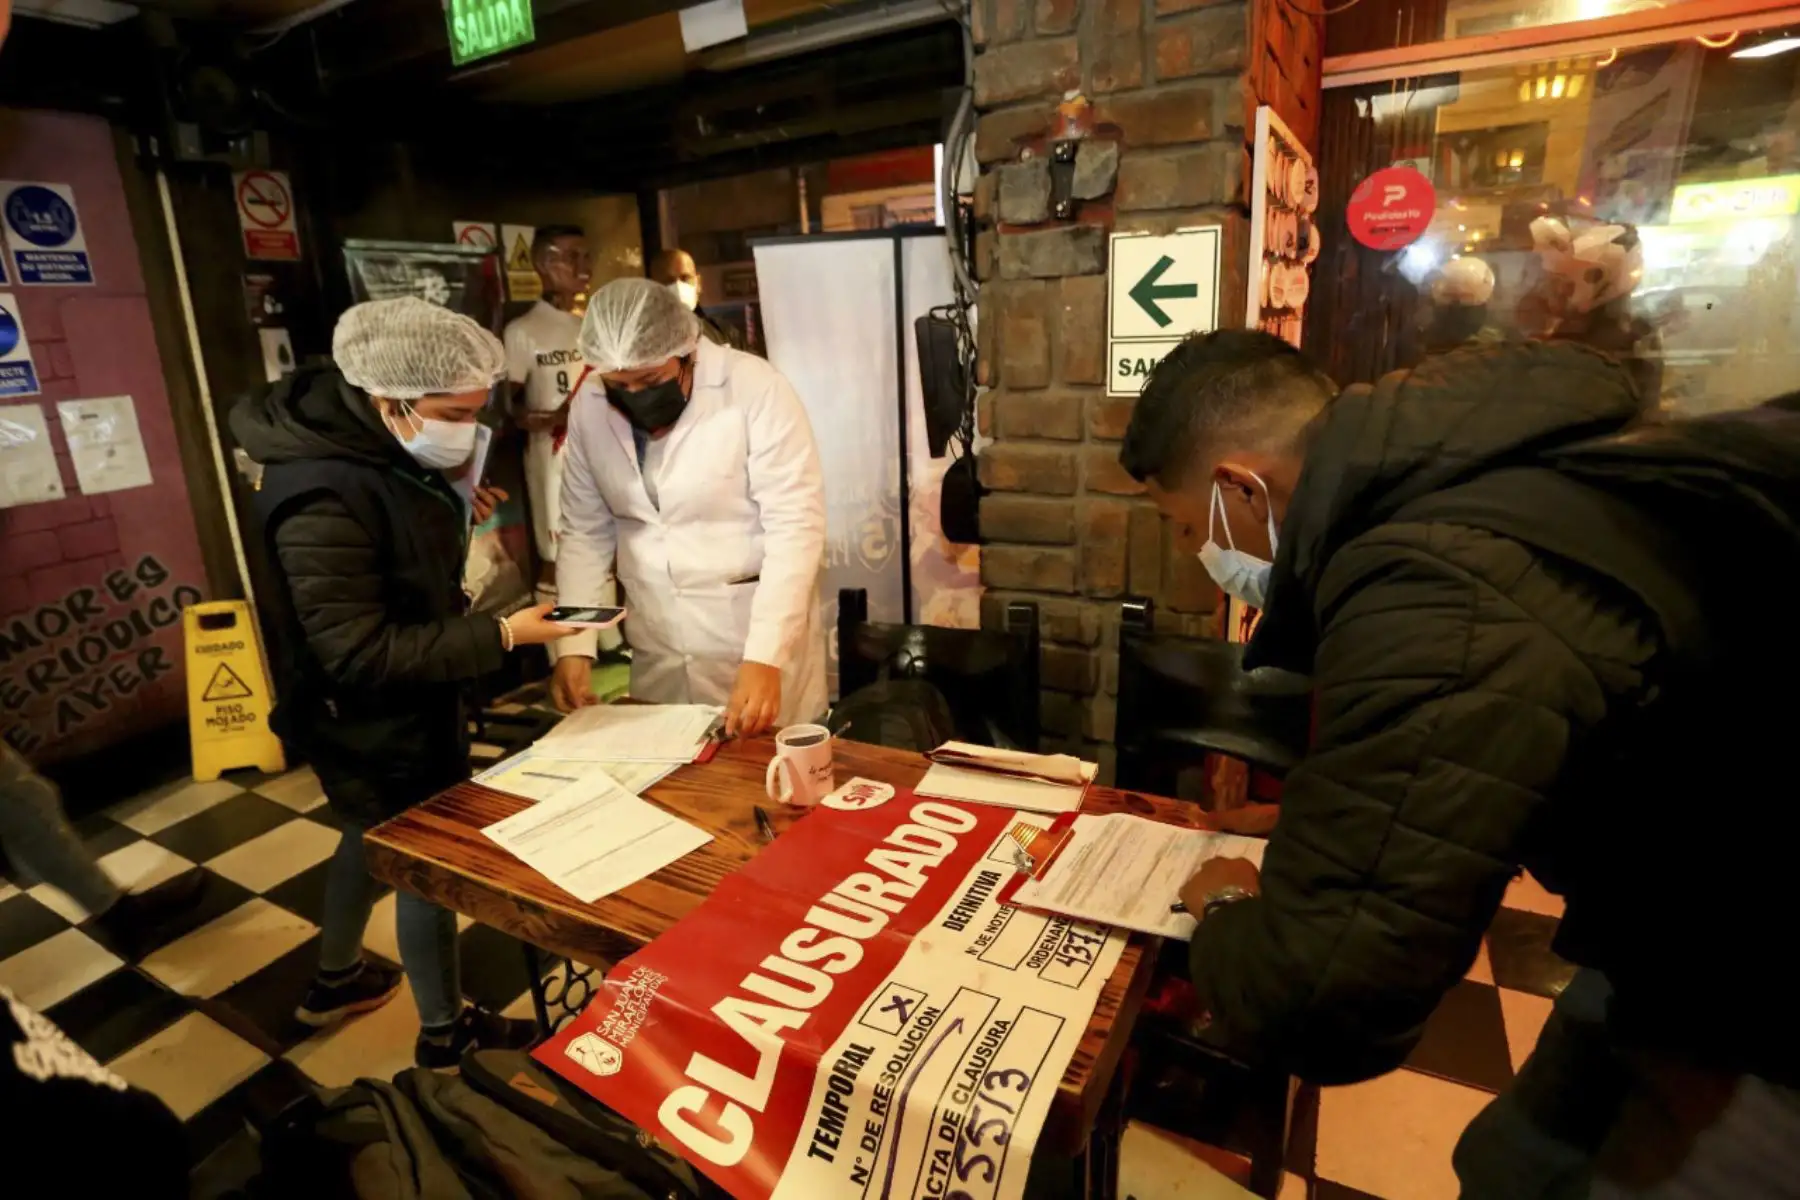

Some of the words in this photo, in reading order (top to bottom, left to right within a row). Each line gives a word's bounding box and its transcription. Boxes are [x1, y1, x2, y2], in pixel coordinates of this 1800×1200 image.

[454, 0, 526, 56] SALIDA
[556, 370, 569, 395] 9
[55, 645, 173, 734] AYER
[942, 869, 1002, 932] DEFINITIVA
[974, 933, 992, 947] DE
[596, 1008, 620, 1036] SAN
[613, 974, 638, 1010] JUAN
[608, 971, 661, 1042] MIRAFLORES
[657, 801, 978, 1167] CLAUSURADO
[870, 1006, 941, 1118] RESOLUCIÓN
[938, 1108, 961, 1144] DE
[951, 1020, 1011, 1105] CLAUSURA
[807, 1042, 876, 1164] TEMPORAL
[860, 1119, 882, 1154] DE
[850, 1156, 869, 1187] N°
